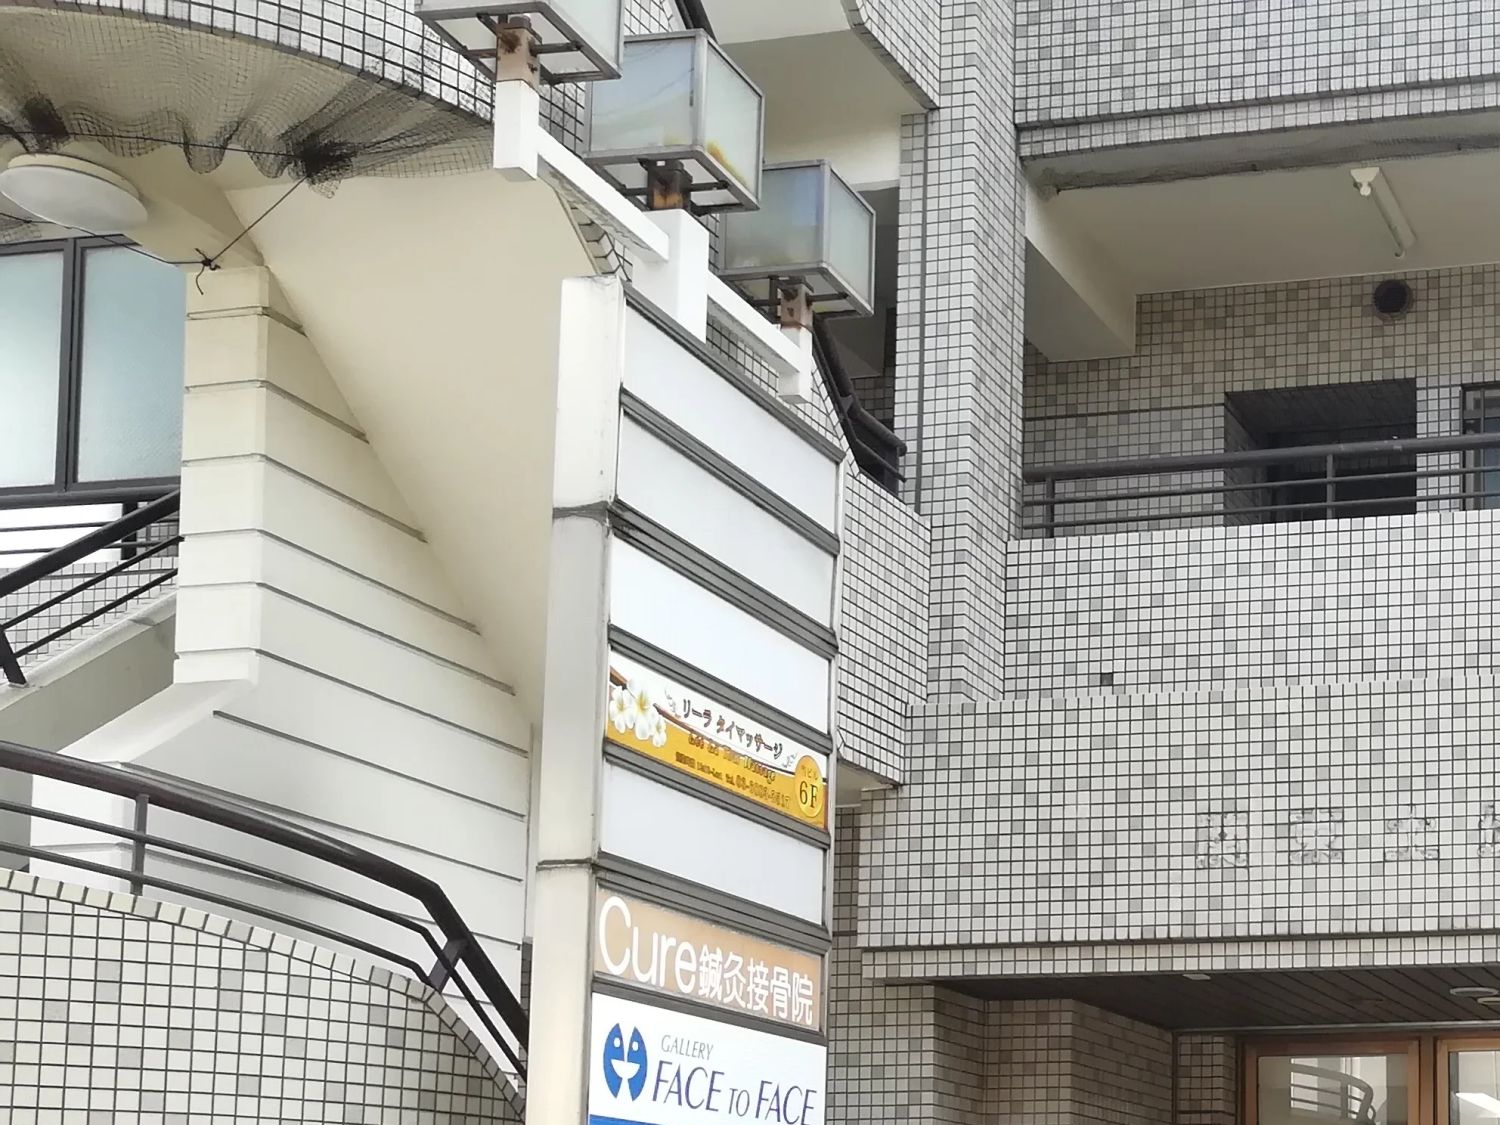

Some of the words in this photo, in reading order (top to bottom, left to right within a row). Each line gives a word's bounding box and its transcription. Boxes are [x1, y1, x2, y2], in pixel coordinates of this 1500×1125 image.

[682, 698, 713, 728] リーラ
[716, 714, 783, 760] タイマッサージ
[799, 780, 818, 808] 6F
[661, 1034, 714, 1061] GALLERY
[652, 1060, 725, 1112] FACE
[728, 1086, 750, 1117] TO
